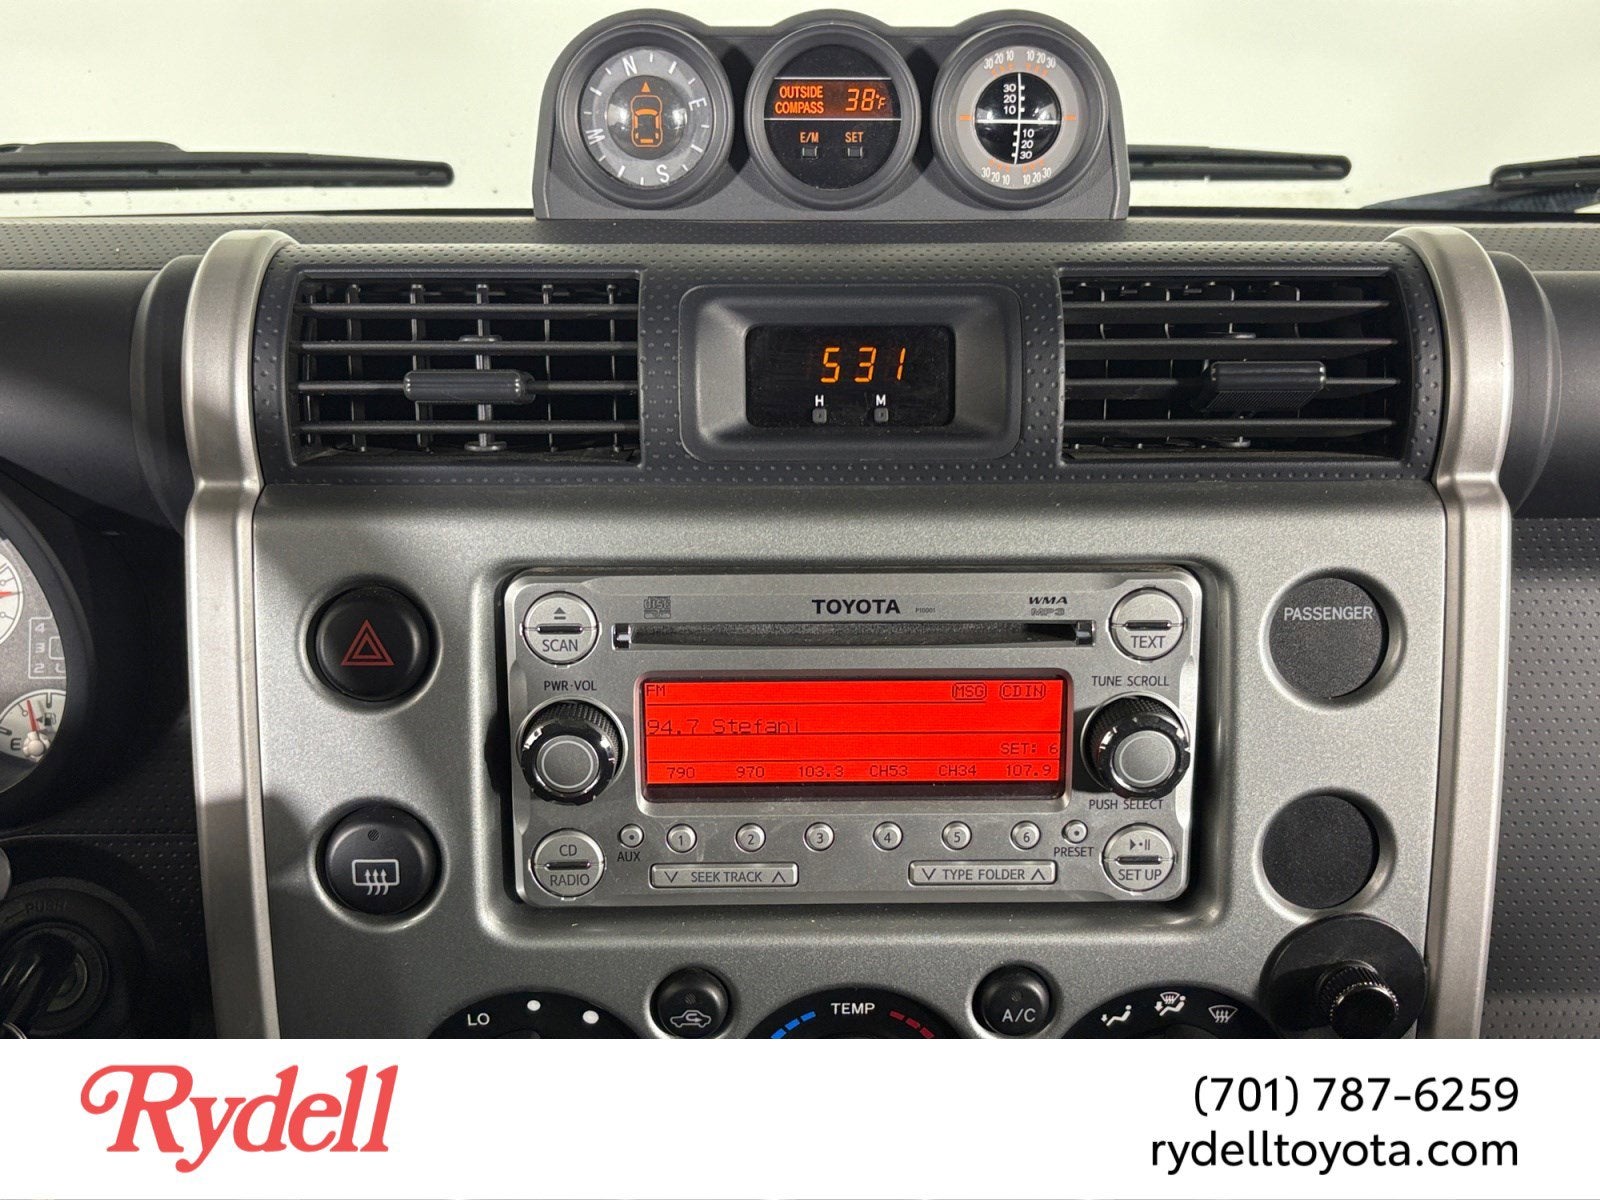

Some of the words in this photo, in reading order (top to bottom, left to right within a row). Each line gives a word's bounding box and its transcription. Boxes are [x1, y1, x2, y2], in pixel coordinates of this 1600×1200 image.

[622, 55, 638, 76] N
[779, 86, 824, 99] OUTSIDE
[1003, 83, 1017, 93] 30
[688, 97, 707, 111] E
[1003, 94, 1017, 103] 20
[775, 101, 824, 114] COMPASS
[1003, 105, 1017, 115] 10
[800, 131, 819, 143] E/M
[845, 131, 864, 143] SET
[1022, 129, 1035, 138] 10
[1021, 140, 1034, 149] 20
[1019, 151, 1032, 159] 30
[656, 164, 670, 183] S
[815, 394, 825, 407] H
[876, 394, 886, 407] M
[1029, 596, 1068, 604] WMA
[812, 599, 901, 615] TOYOTA
[1284, 606, 1374, 620] PASSENGER
[35, 623, 46, 633] 4
[542, 639, 578, 652] SCAN
[1131, 636, 1165, 648] TEXT
[1092, 676, 1122, 687] TUNE
[1127, 675, 1170, 687] SCROLL
[646, 684, 666, 697] FM
[954, 685, 985, 697] MSG
[647, 719, 699, 735] 94.7
[10, 738, 22, 750] E
[1000, 742, 1036, 754] SET:
[666, 767, 695, 778] 790
[735, 766, 765, 778] 970
[799, 766, 844, 778] 103.3
[869, 765, 908, 777] CH53
[938, 765, 977, 777] CH34
[1006, 764, 1051, 776] 107.9
[1089, 799, 1118, 810] PUSH
[1122, 799, 1164, 810] SELECT
[747, 834, 755, 845] 2
[816, 832, 824, 843] 3
[883, 832, 892, 843] 4
[953, 831, 961, 843] 5
[1023, 831, 1031, 843] 6
[559, 844, 578, 857] CD
[616, 851, 641, 862] AUX
[1053, 847, 1094, 858] PRESET
[550, 873, 590, 886] RADIO
[691, 871, 723, 882] SEEK
[724, 871, 762, 882] TRACK
[942, 868, 973, 881] TYPE
[978, 868, 1025, 881] FOLDER
[1118, 868, 1141, 881] SET
[1143, 868, 1162, 881] UP
[831, 1002, 876, 1016] TEMP
[1001, 1007, 1036, 1023] A/C
[467, 1012, 490, 1026] LO
